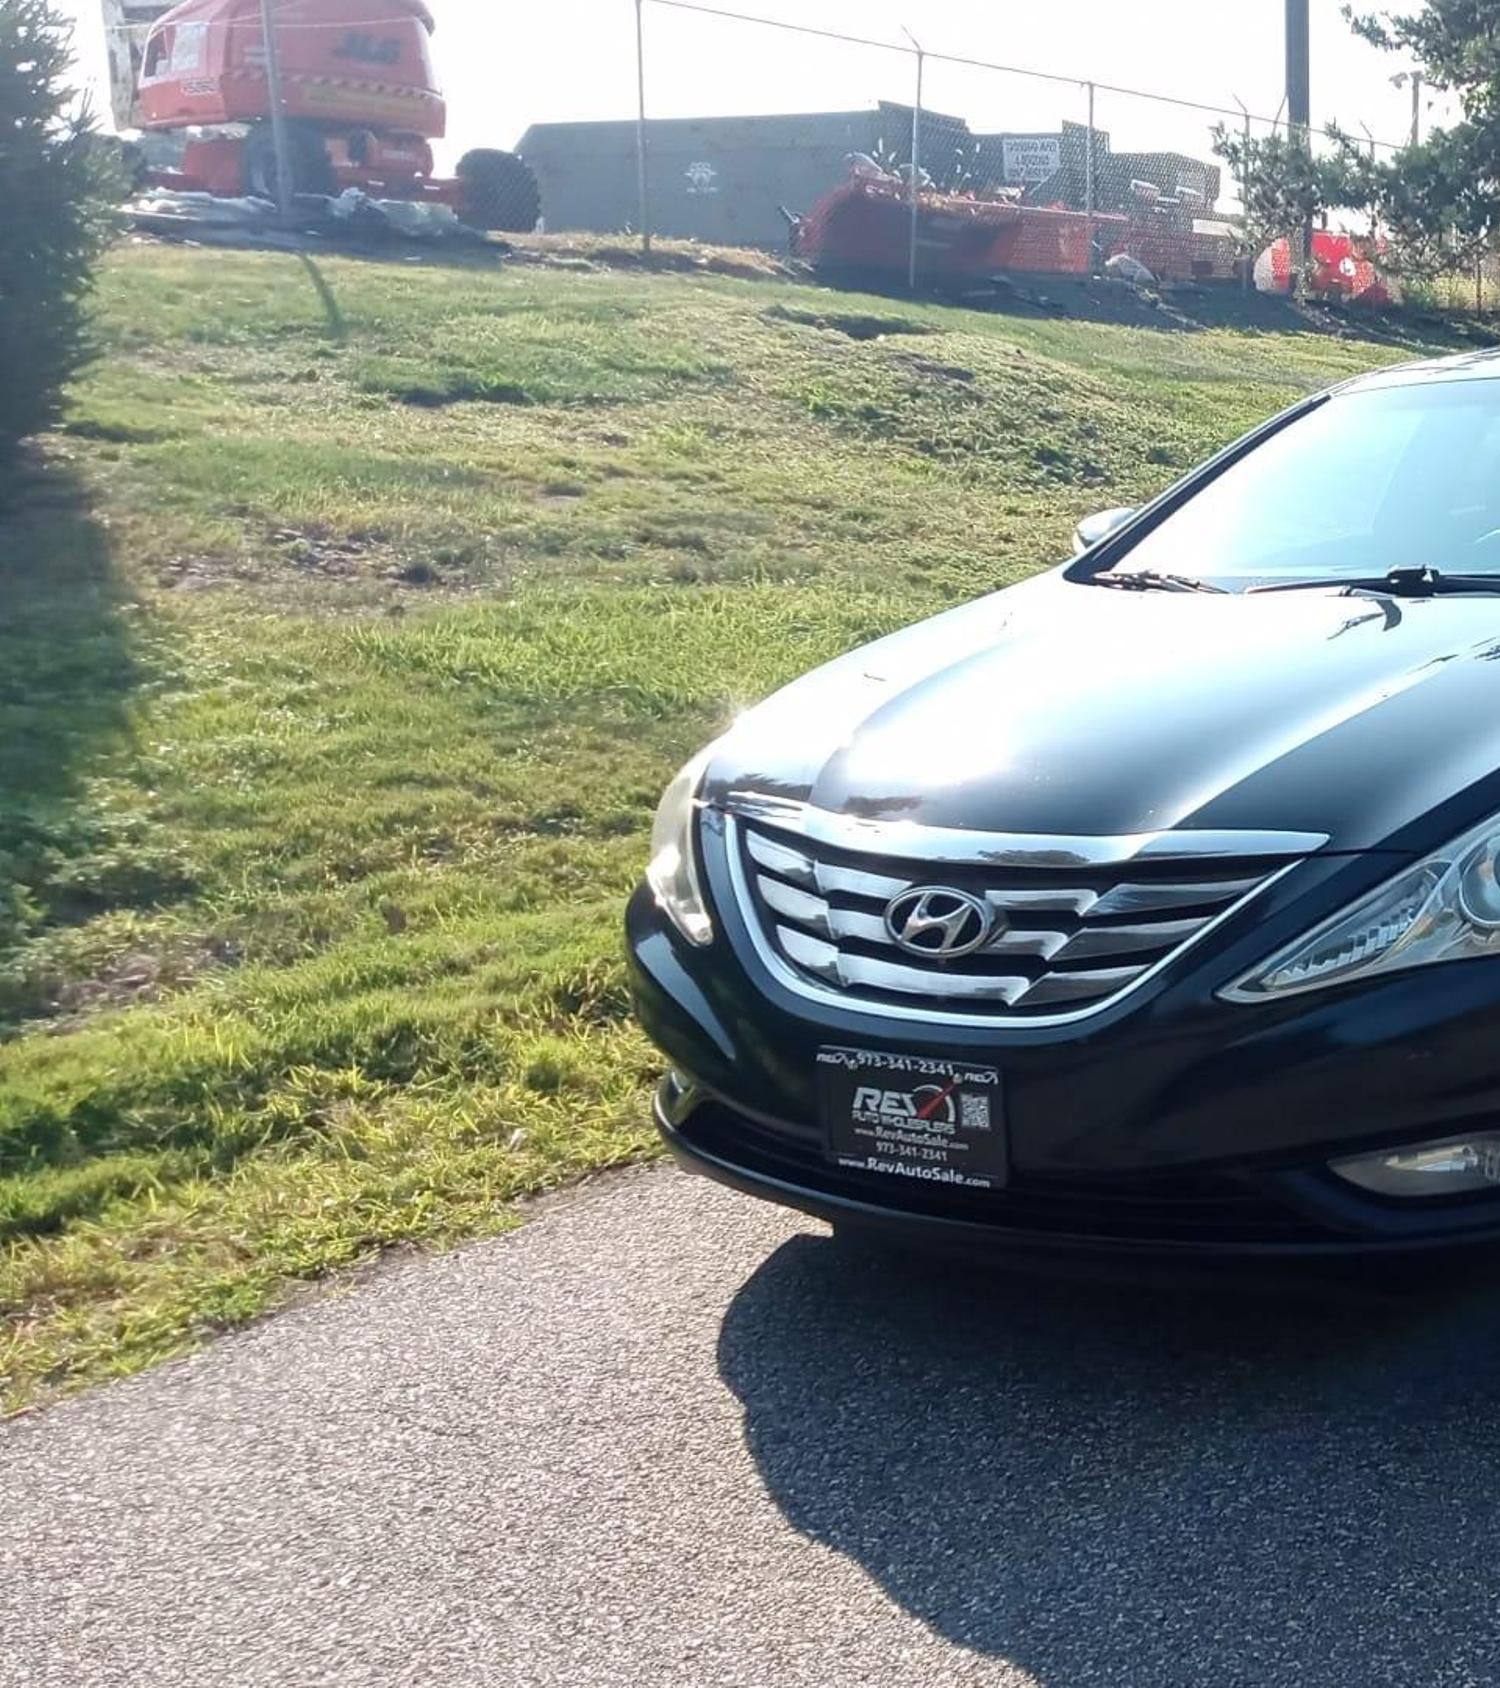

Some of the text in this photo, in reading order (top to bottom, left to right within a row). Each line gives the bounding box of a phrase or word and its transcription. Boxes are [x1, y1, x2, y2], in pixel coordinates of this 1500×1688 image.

[856, 1053, 954, 1076] 973-341-2341
[855, 1126, 969, 1150] www.RevAutoSale.com
[838, 1157, 990, 1188] www.RevAutoSale.com
